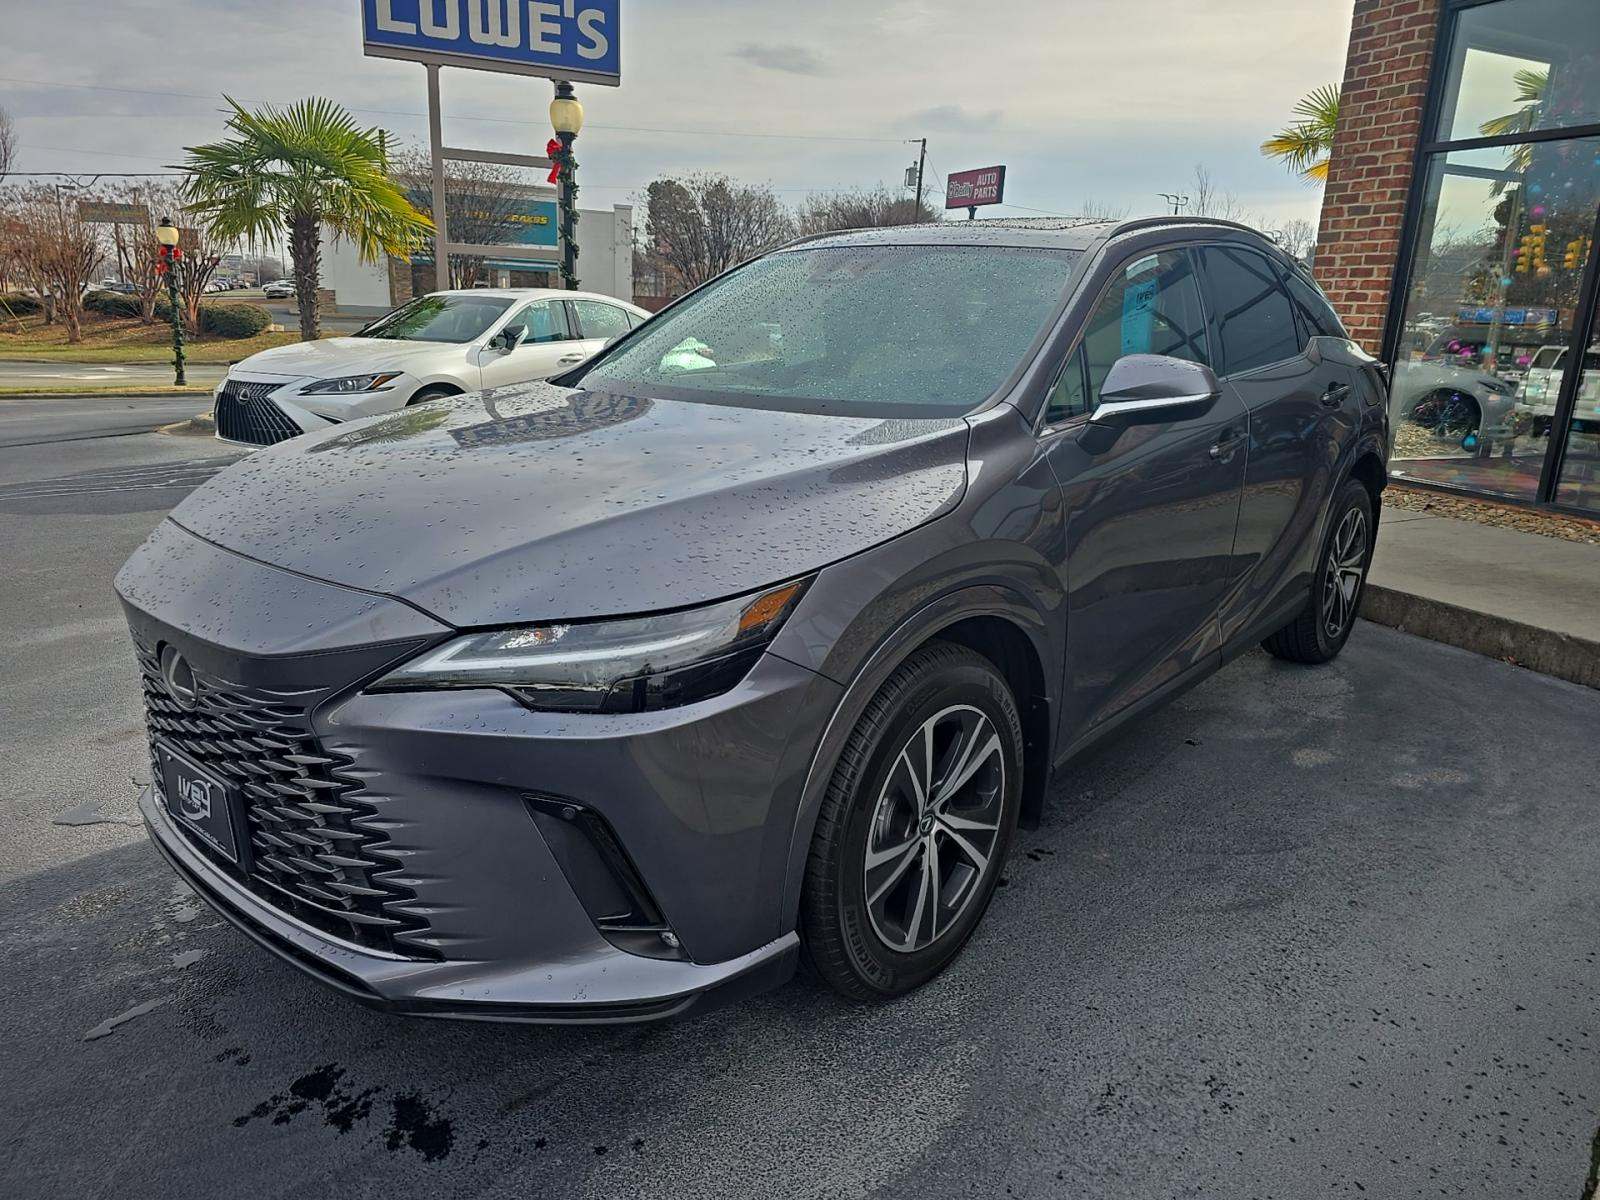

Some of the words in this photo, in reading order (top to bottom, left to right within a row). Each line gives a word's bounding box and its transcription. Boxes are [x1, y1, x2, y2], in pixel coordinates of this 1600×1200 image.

[376, 0, 609, 60] LOWE'S
[977, 173, 997, 186] AUTO
[973, 186, 998, 200] PARTS
